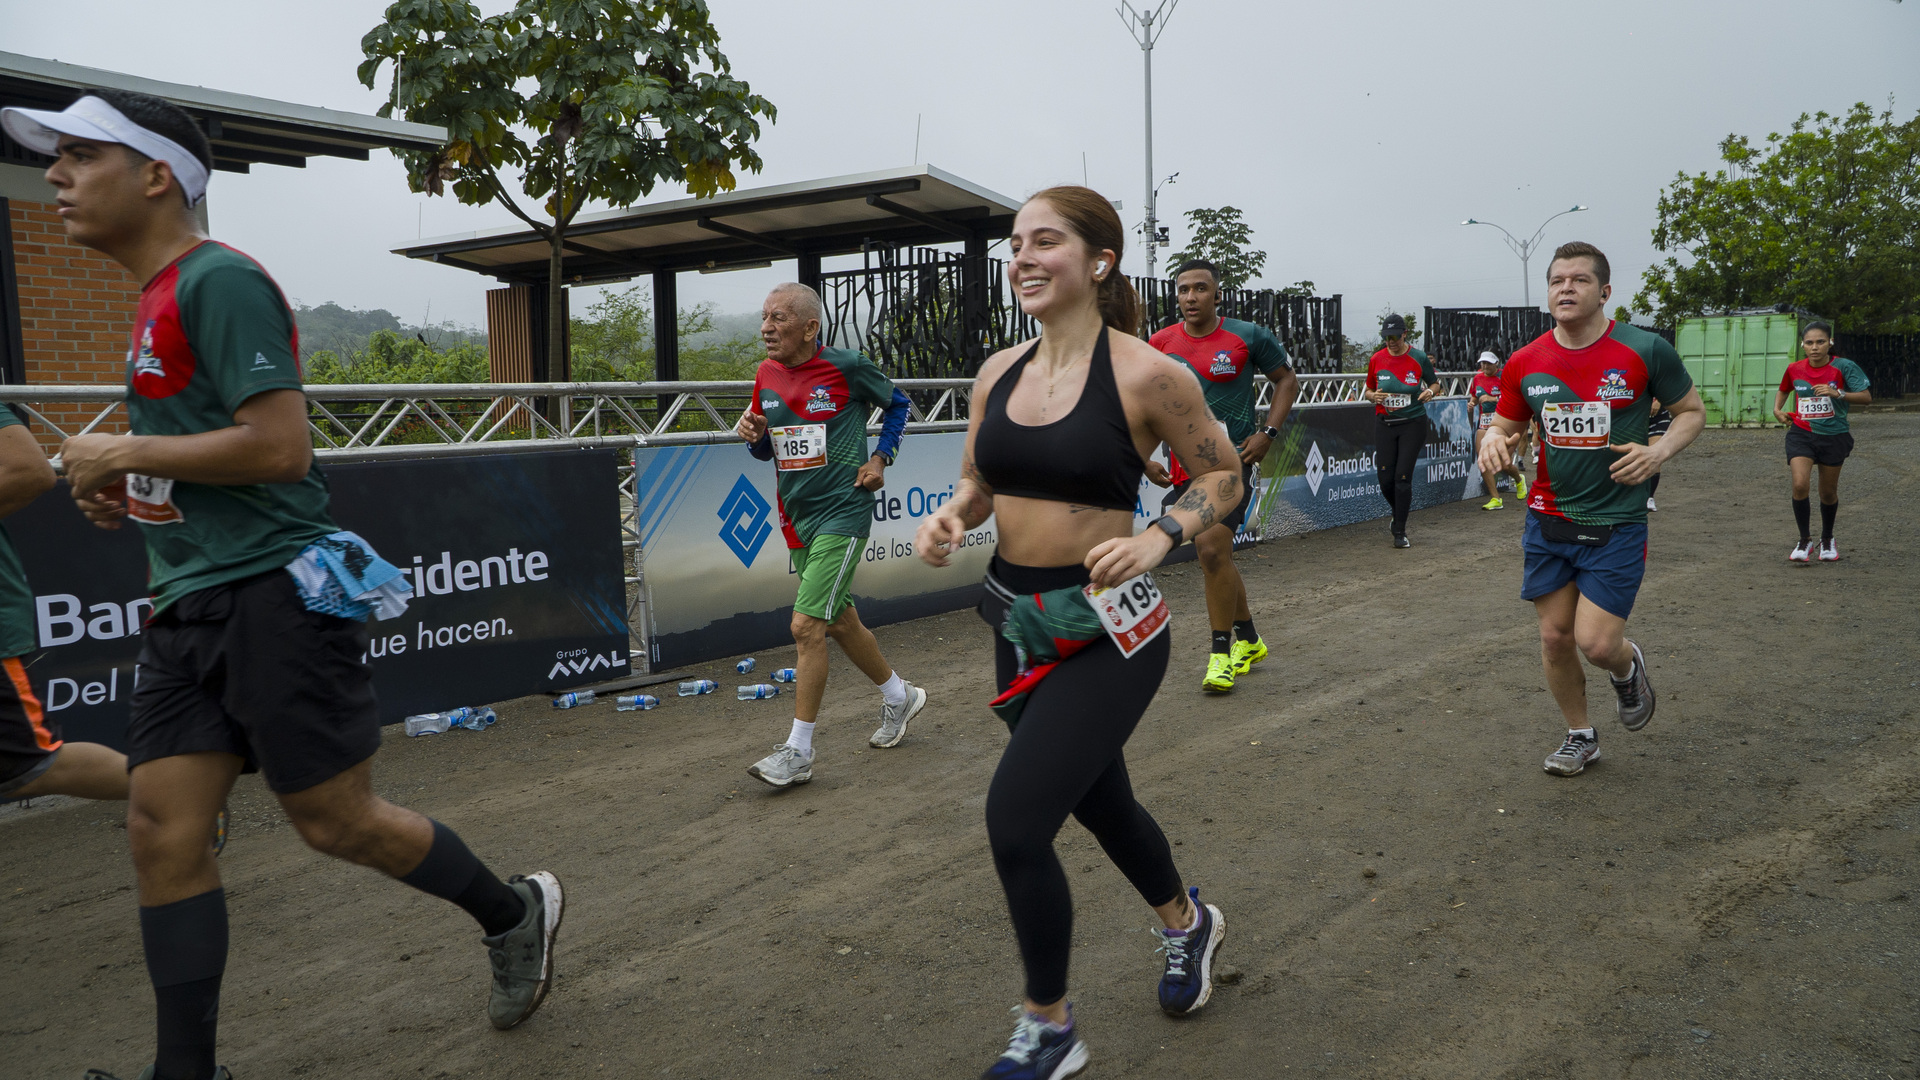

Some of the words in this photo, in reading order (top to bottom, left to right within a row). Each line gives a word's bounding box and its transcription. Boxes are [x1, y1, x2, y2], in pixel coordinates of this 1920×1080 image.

[1385, 399, 1405, 407] 1151
[1804, 403, 1829, 413] 1393
[1548, 416, 1595, 434] 2161
[783, 439, 809, 457] 185
[1425, 443, 1437, 460] TU
[1439, 439, 1469, 459] HACER,
[1328, 455, 1357, 477] Banco
[1359, 452, 1371, 473] de
[1427, 460, 1469, 484] IMPACTA.
[1328, 487, 1341, 502] Del
[1341, 483, 1356, 499] lado
[1356, 482, 1365, 496] de
[1365, 481, 1375, 495] los
[873, 489, 901, 522] de
[865, 540, 886, 563] de
[890, 537, 913, 559] los
[960, 530, 995, 549] acen.
[35, 593, 156, 649] Ban
[399, 547, 549, 600] idente
[47, 667, 118, 712] Del
[417, 617, 514, 650] hacen.
[556, 647, 588, 660] Grupo
[548, 650, 626, 681] AVAL
